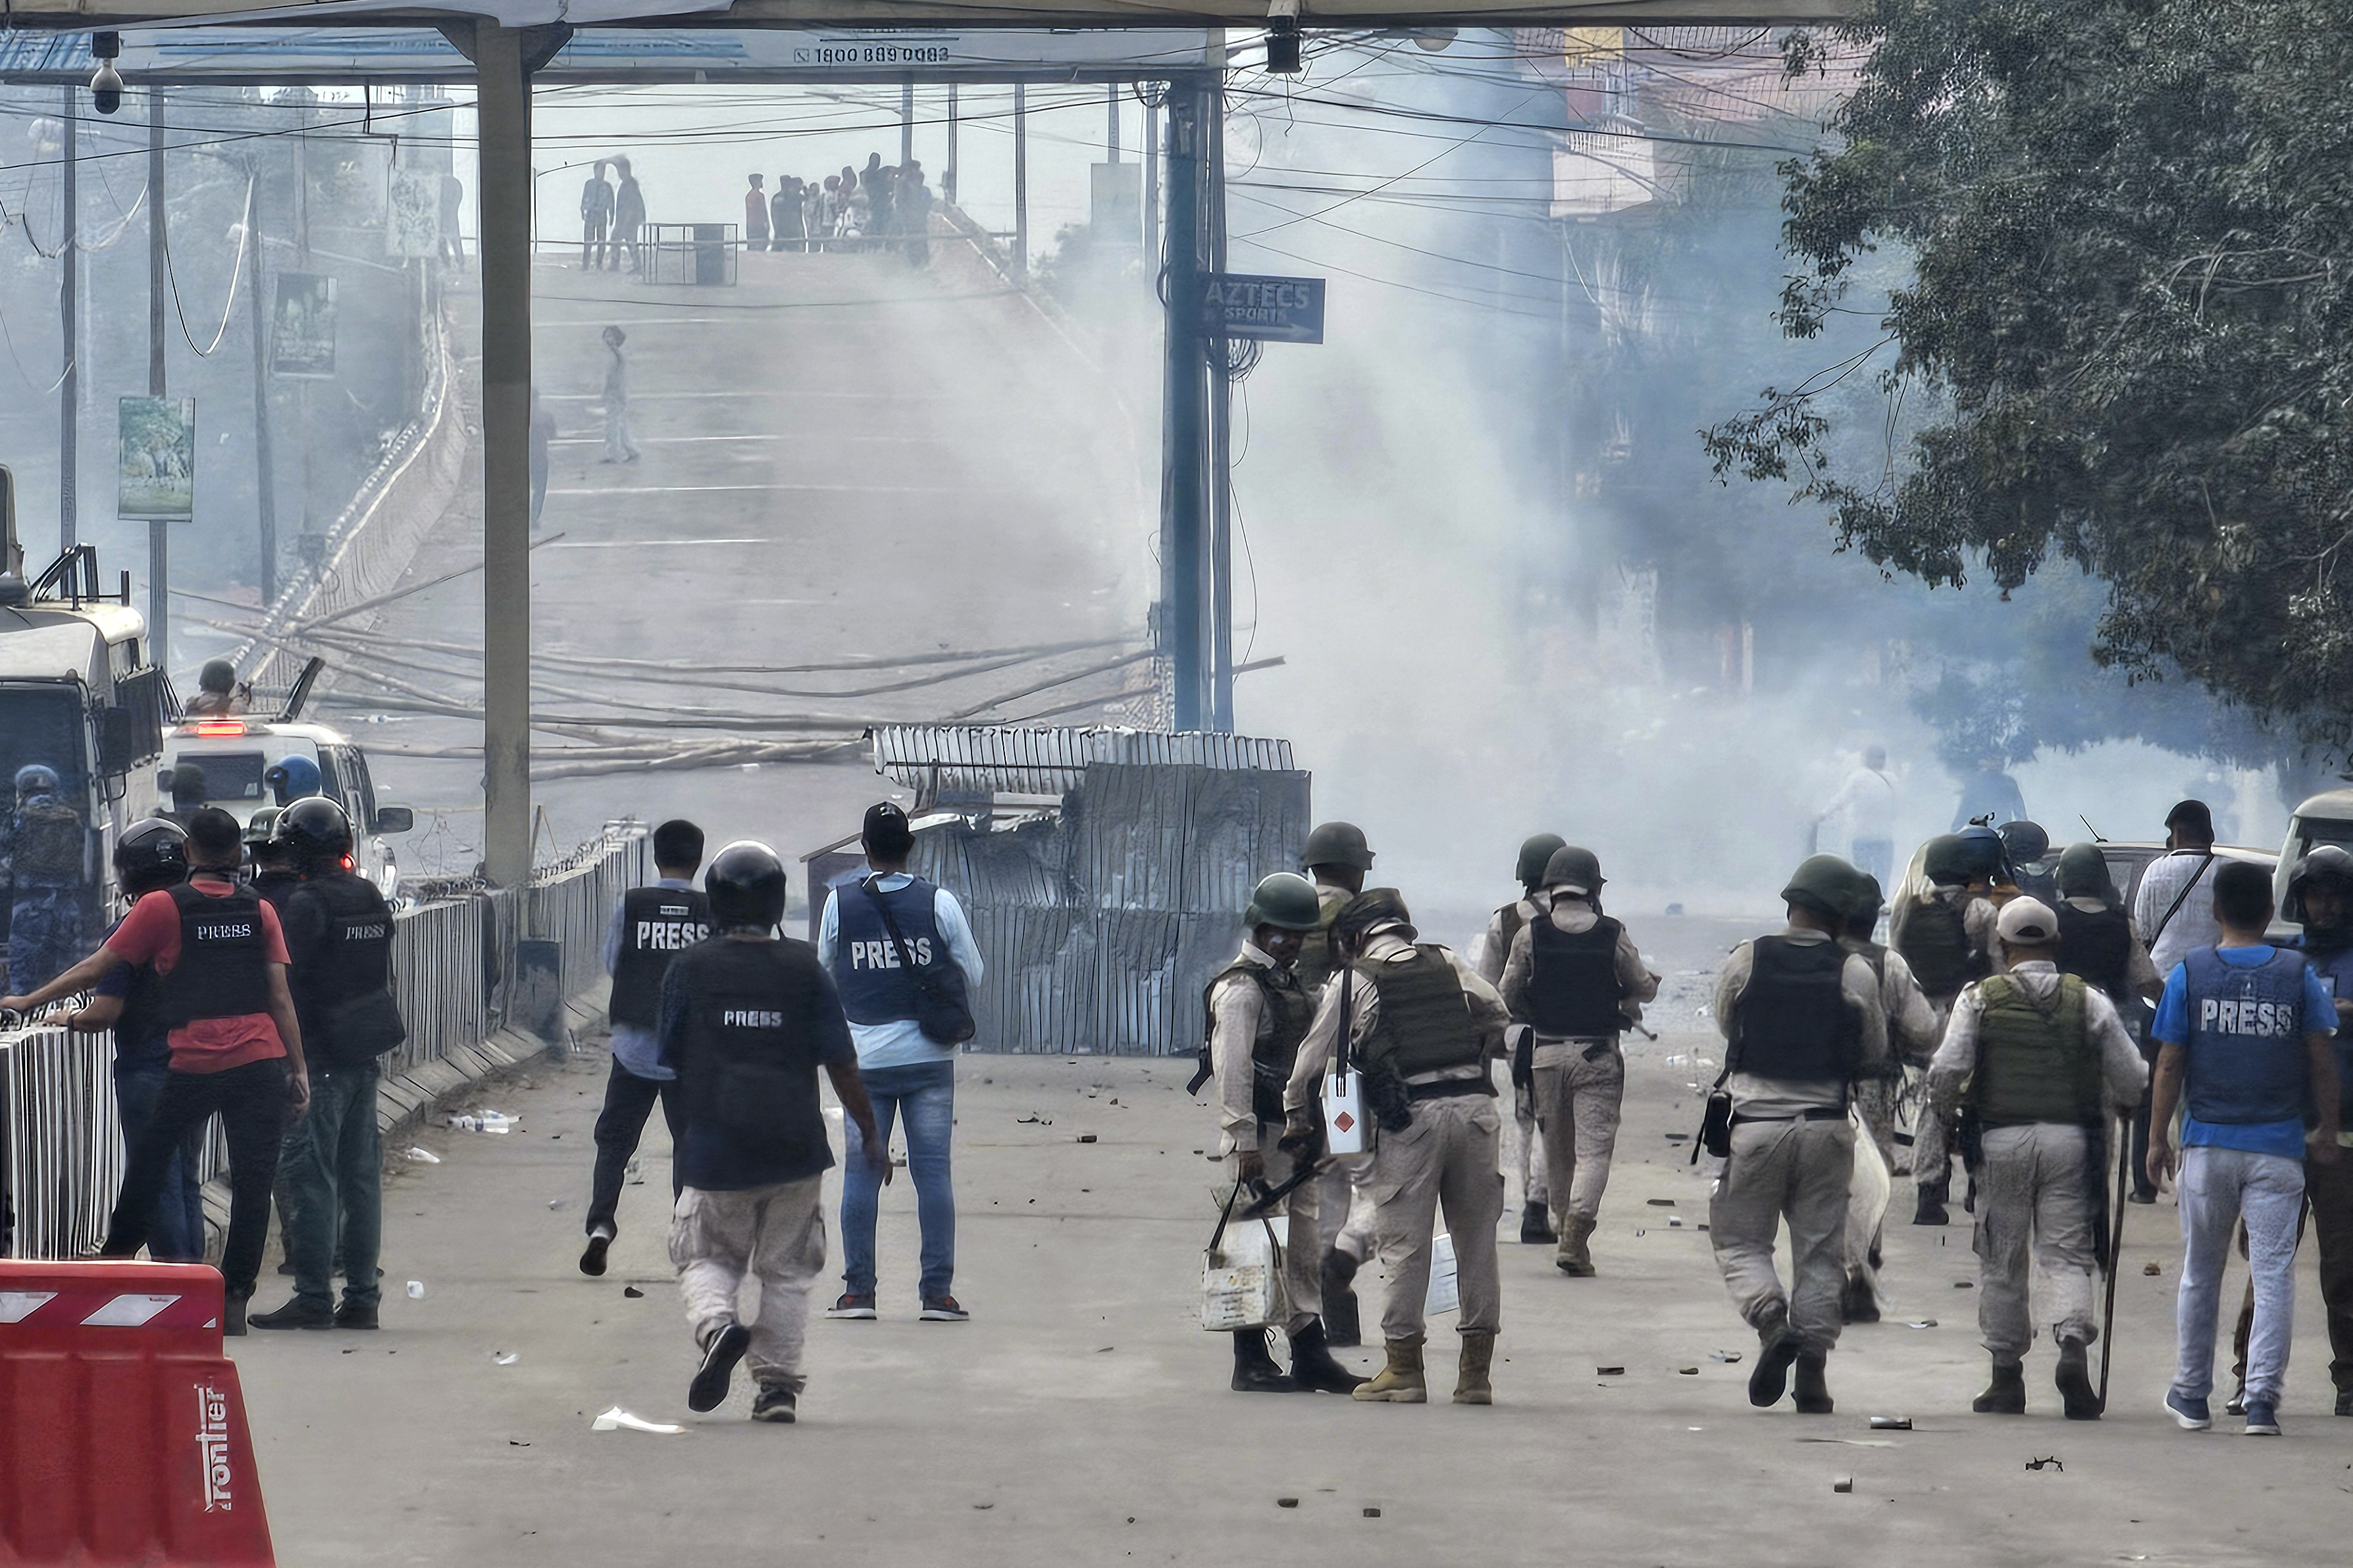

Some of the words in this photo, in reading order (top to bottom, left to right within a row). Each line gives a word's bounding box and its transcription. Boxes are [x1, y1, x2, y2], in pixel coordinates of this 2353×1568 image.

[1204, 280, 1310, 309] AZTECS
[198, 924, 251, 940] PRESS
[346, 924, 386, 940] PRESS
[724, 1010, 782, 1027] PRESS
[2200, 998, 2292, 1037] PRESS
